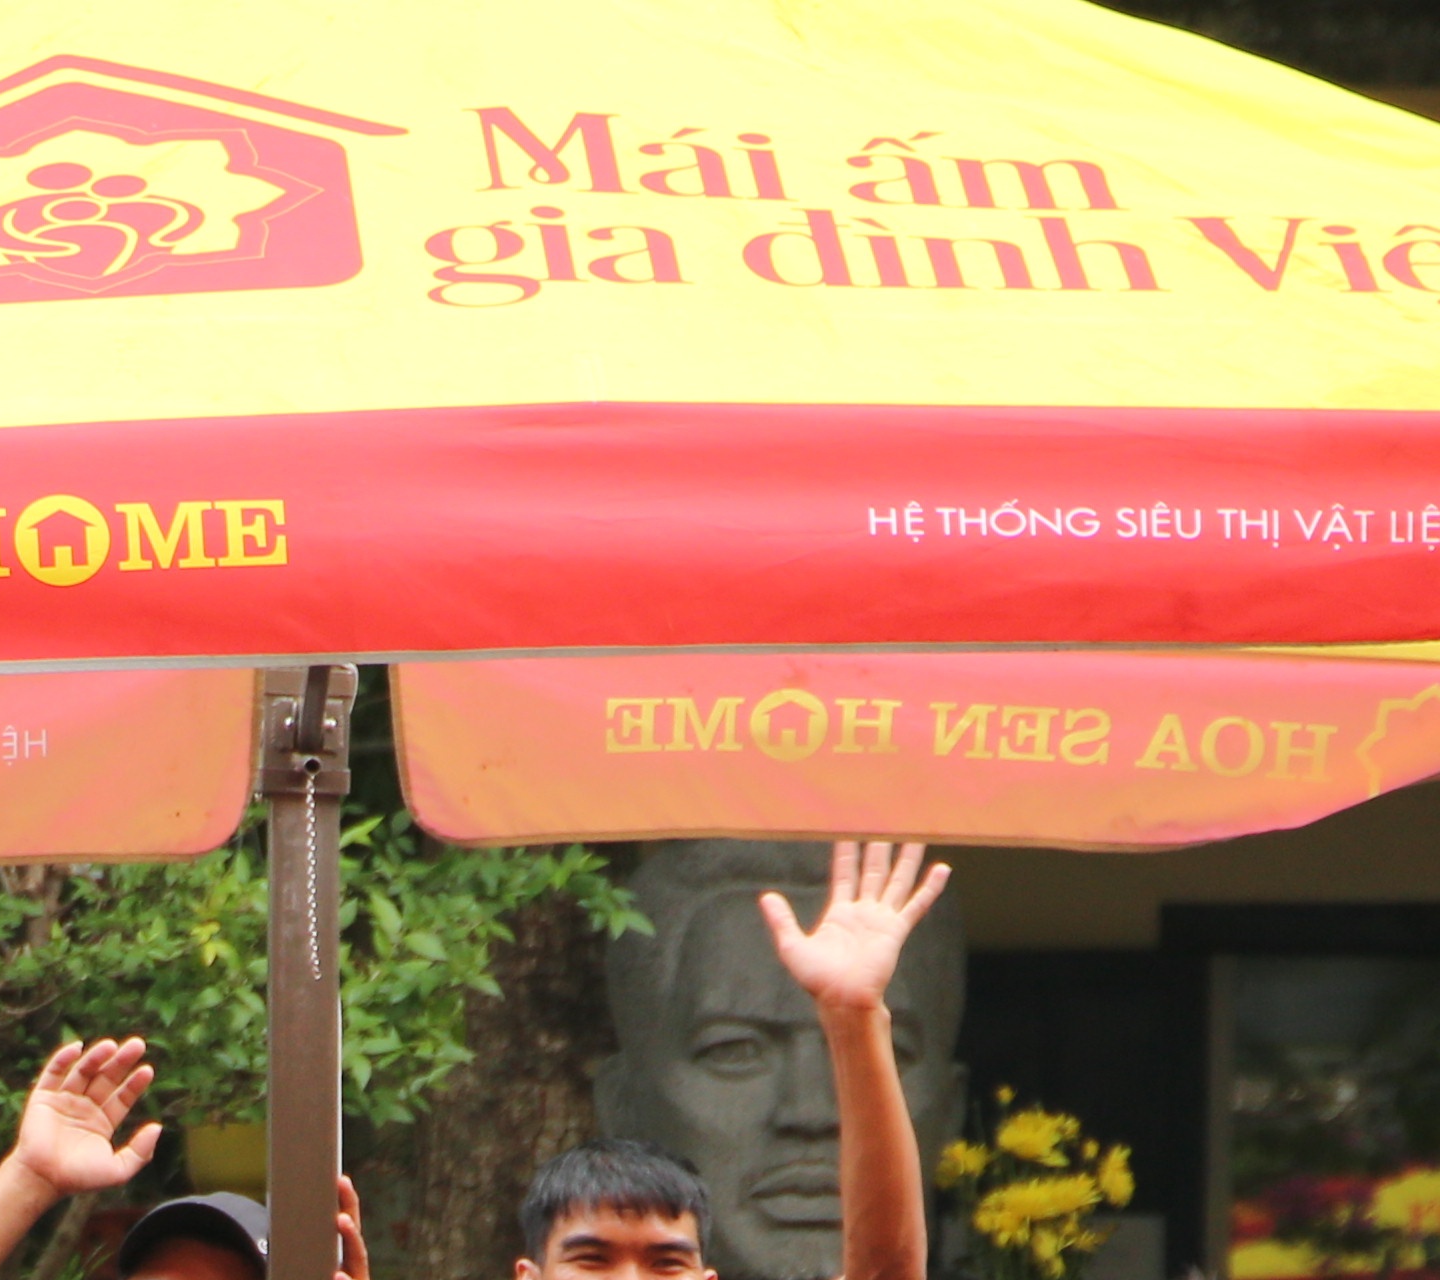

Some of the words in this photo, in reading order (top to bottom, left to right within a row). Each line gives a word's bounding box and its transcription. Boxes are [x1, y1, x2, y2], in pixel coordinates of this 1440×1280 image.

[462, 106, 800, 201] Mái
[845, 131, 1130, 211] ấm
[424, 205, 695, 308] gia
[742, 208, 1171, 292] đình
[867, 501, 925, 543] HỆ
[936, 498, 1101, 538] THỐNG
[1116, 502, 1202, 540] SIÊU
[1217, 507, 1280, 549] THỊ
[1294, 503, 1375, 550] VẬT
